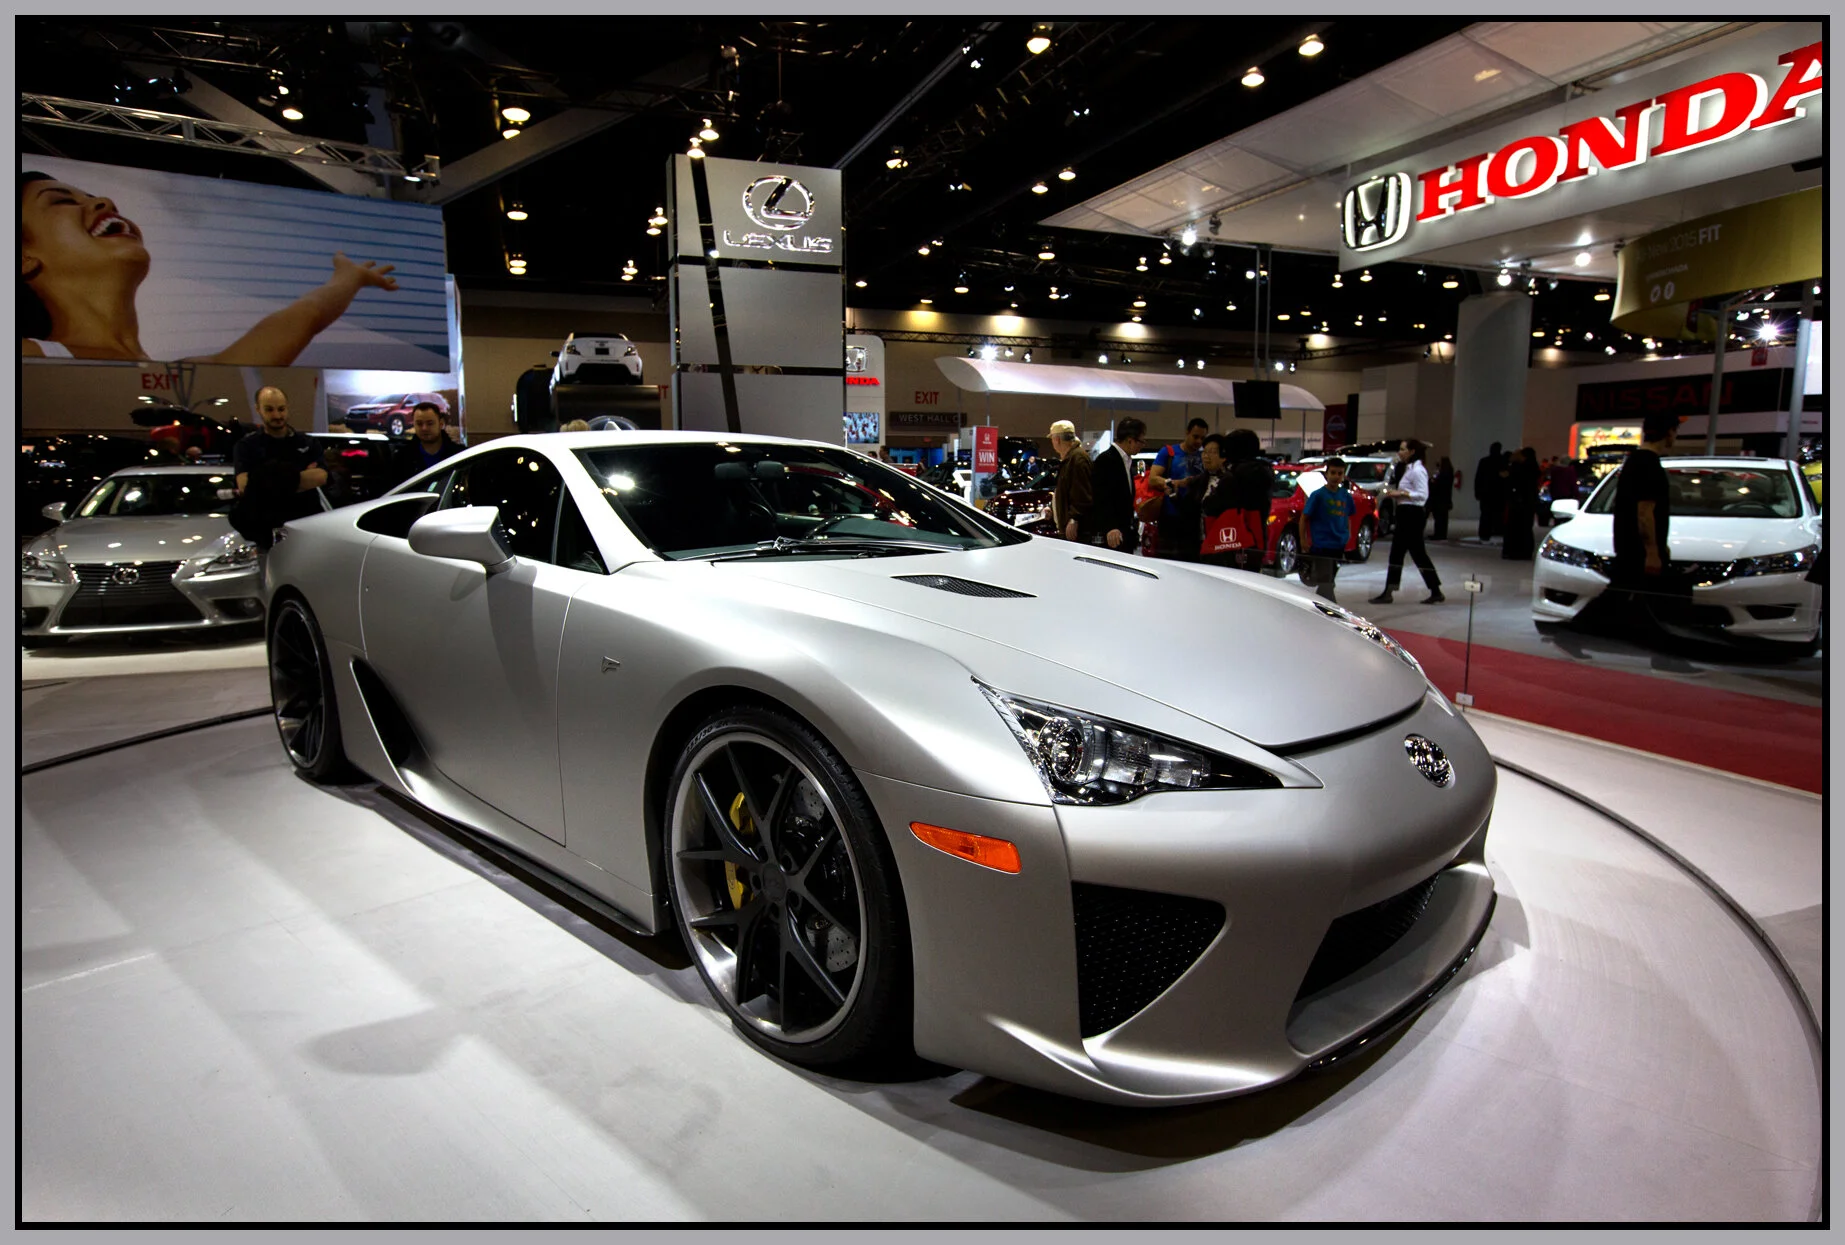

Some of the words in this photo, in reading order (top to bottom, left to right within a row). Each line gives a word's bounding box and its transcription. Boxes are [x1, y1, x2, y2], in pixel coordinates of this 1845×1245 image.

[1416, 41, 1823, 222] HONDA
[723, 230, 833, 253] LEXUS
[1698, 224, 1723, 245] FIT
[141, 373, 179, 390] EXIT
[846, 376, 880, 385] NDA
[915, 391, 939, 404] EXIT
[1582, 380, 1735, 411] NISSAN
[899, 414, 924, 422] WEST
[927, 414, 950, 423] HALL
[978, 451, 995, 463] WIN
[1214, 542, 1242, 551] HONDA
